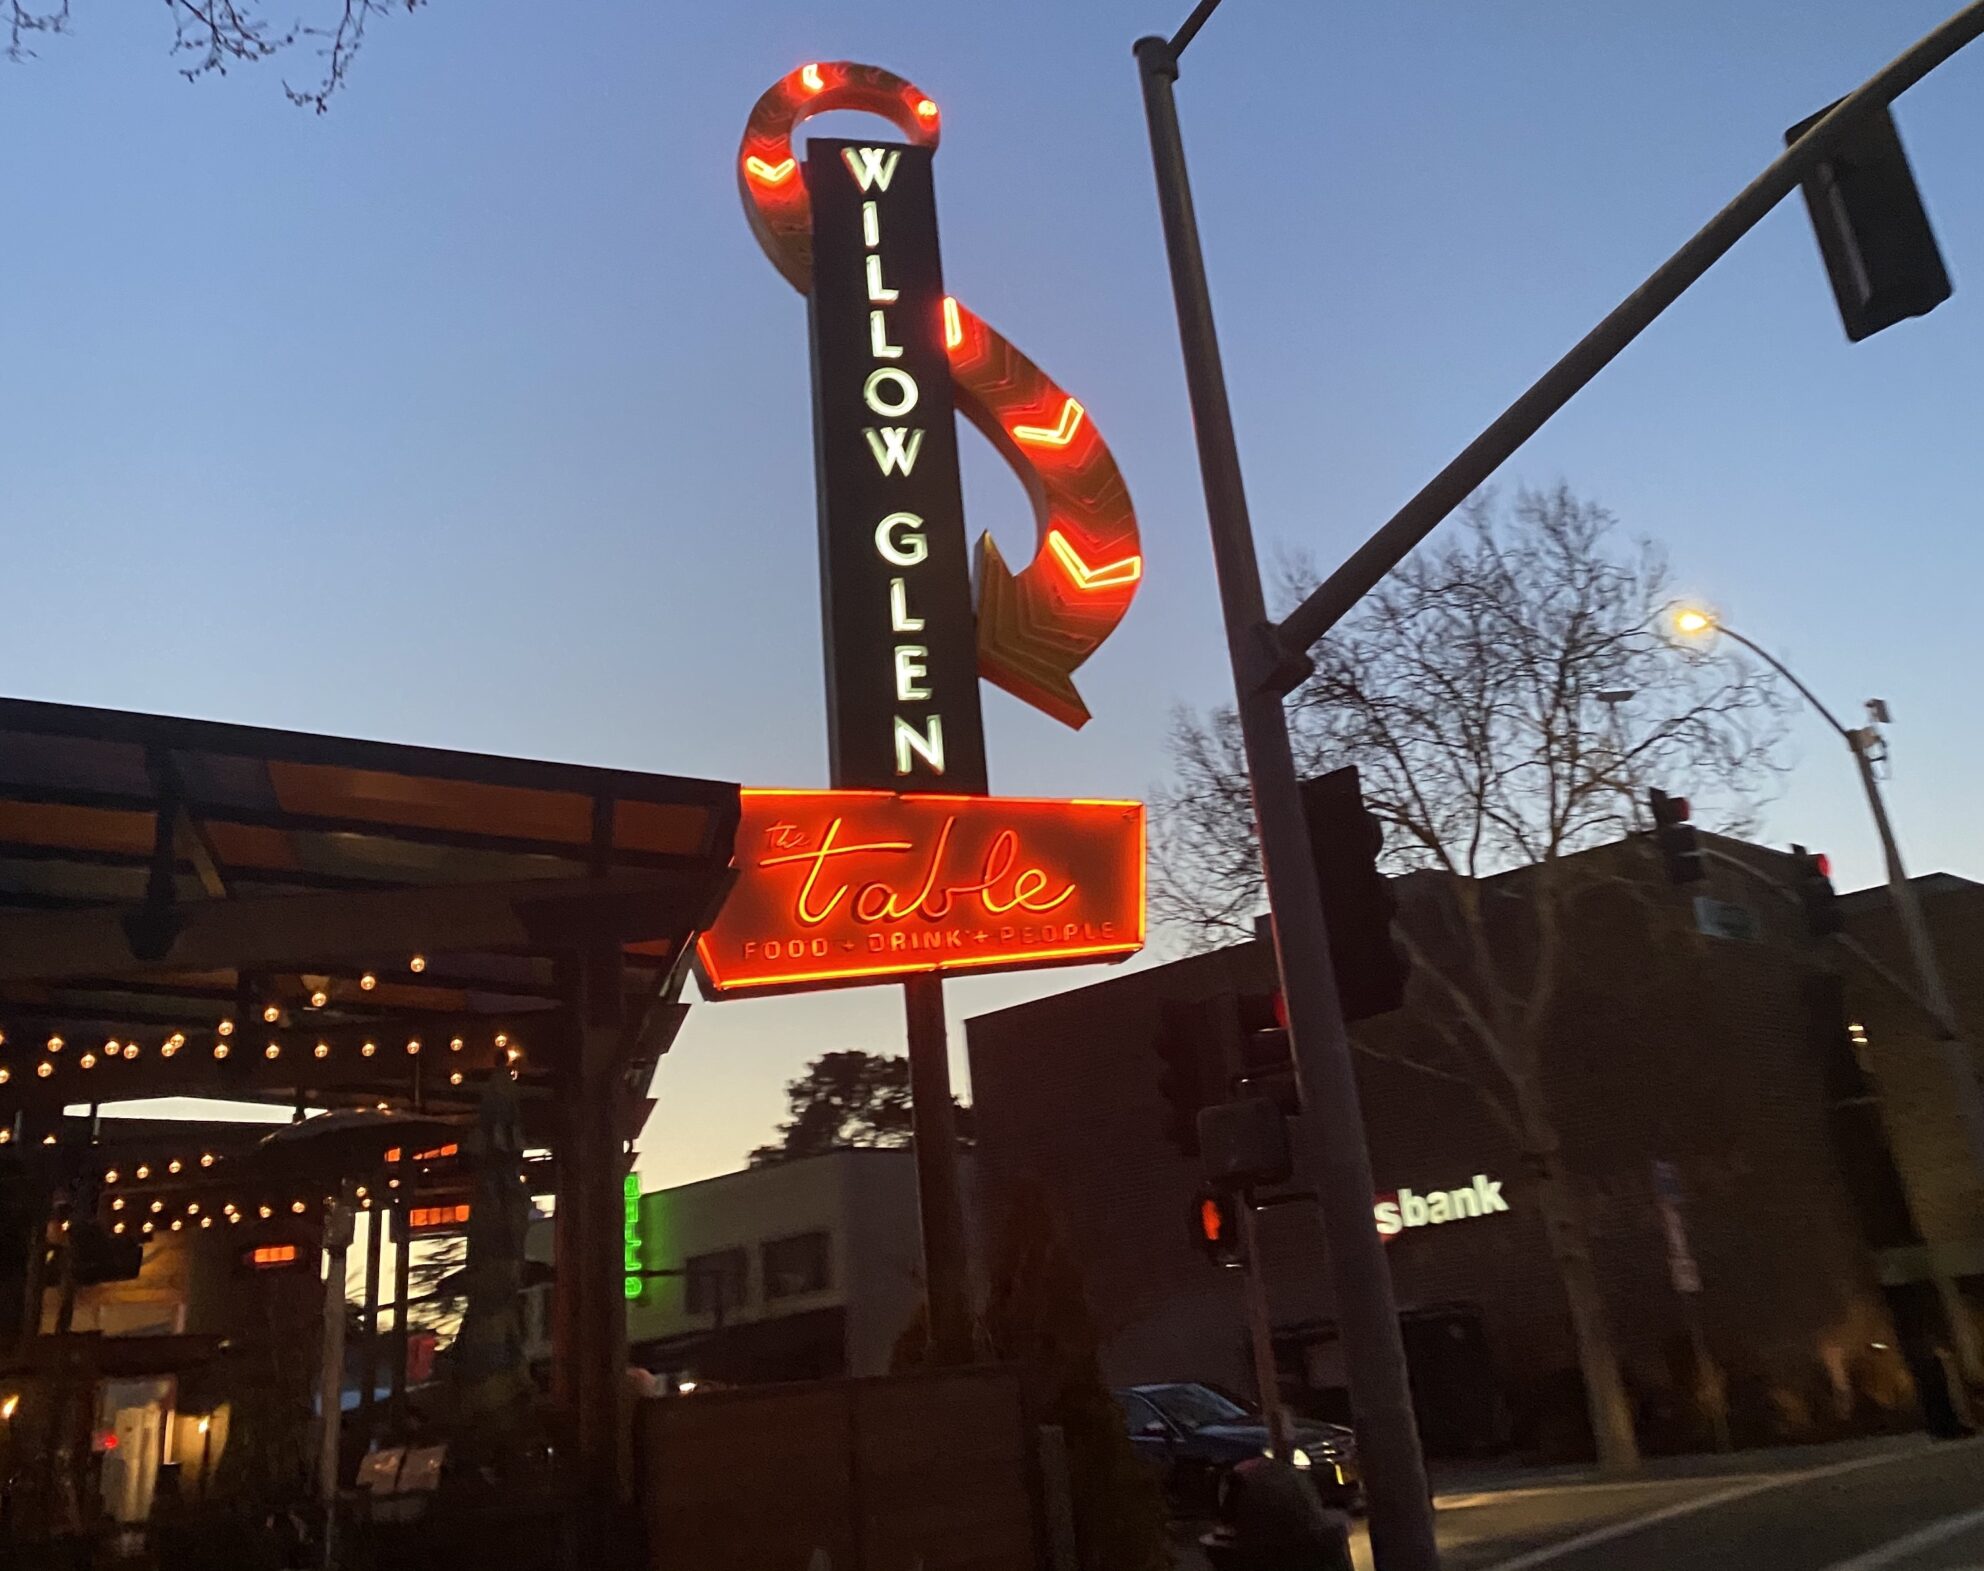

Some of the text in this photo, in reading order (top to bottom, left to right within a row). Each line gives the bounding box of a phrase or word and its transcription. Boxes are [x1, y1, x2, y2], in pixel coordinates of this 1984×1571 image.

[841, 147, 945, 775] WILLOW GLEN
[759, 816, 1076, 923] table
[744, 937, 828, 960] FOOD
[868, 930, 962, 952] DRINK
[999, 921, 1115, 944] PEOPLE
[1373, 1174, 1510, 1234] sbank
